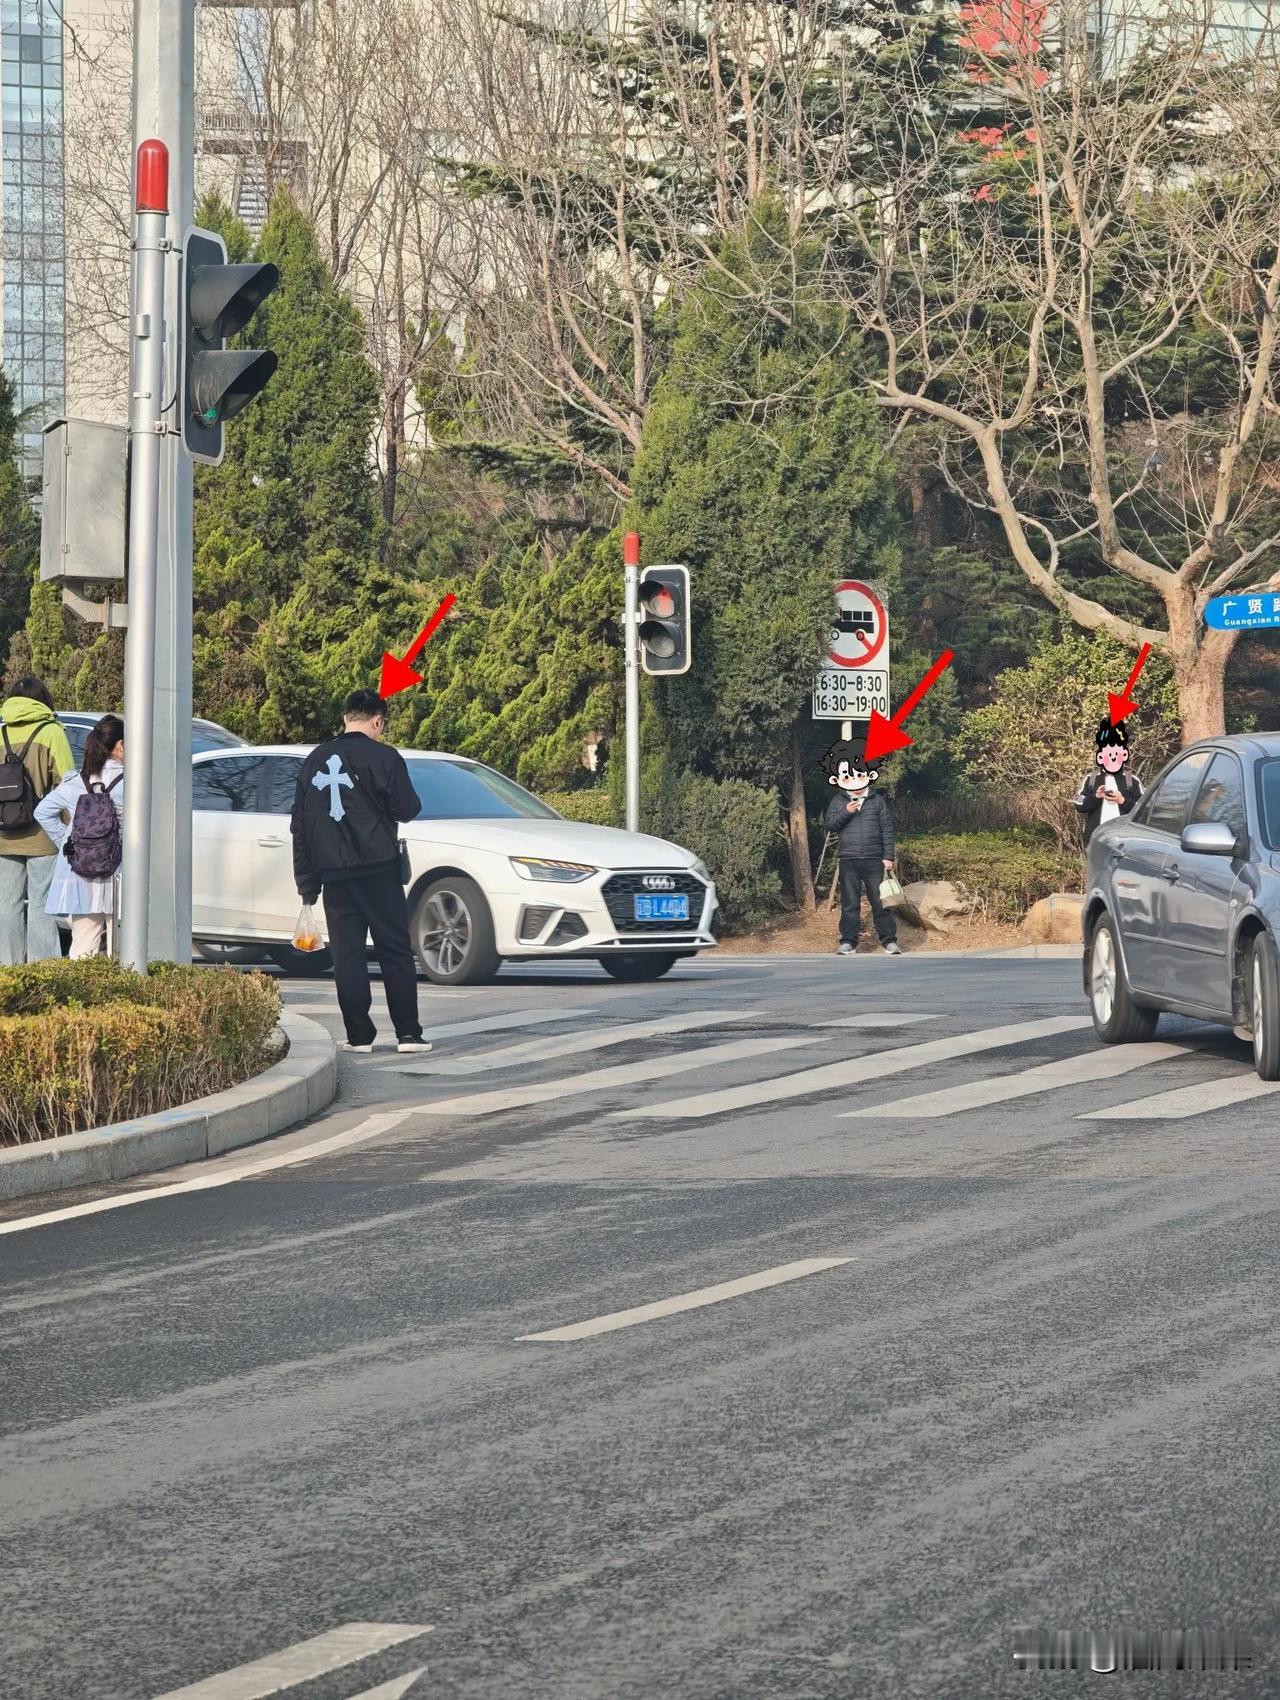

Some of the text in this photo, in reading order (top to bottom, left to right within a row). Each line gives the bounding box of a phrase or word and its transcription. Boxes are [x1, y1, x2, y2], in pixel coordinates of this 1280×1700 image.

[1224, 617, 1271, 626] Guangxian
[821, 674, 882, 691] 6:30-8:30
[816, 694, 886, 712] 16:30-19:00
